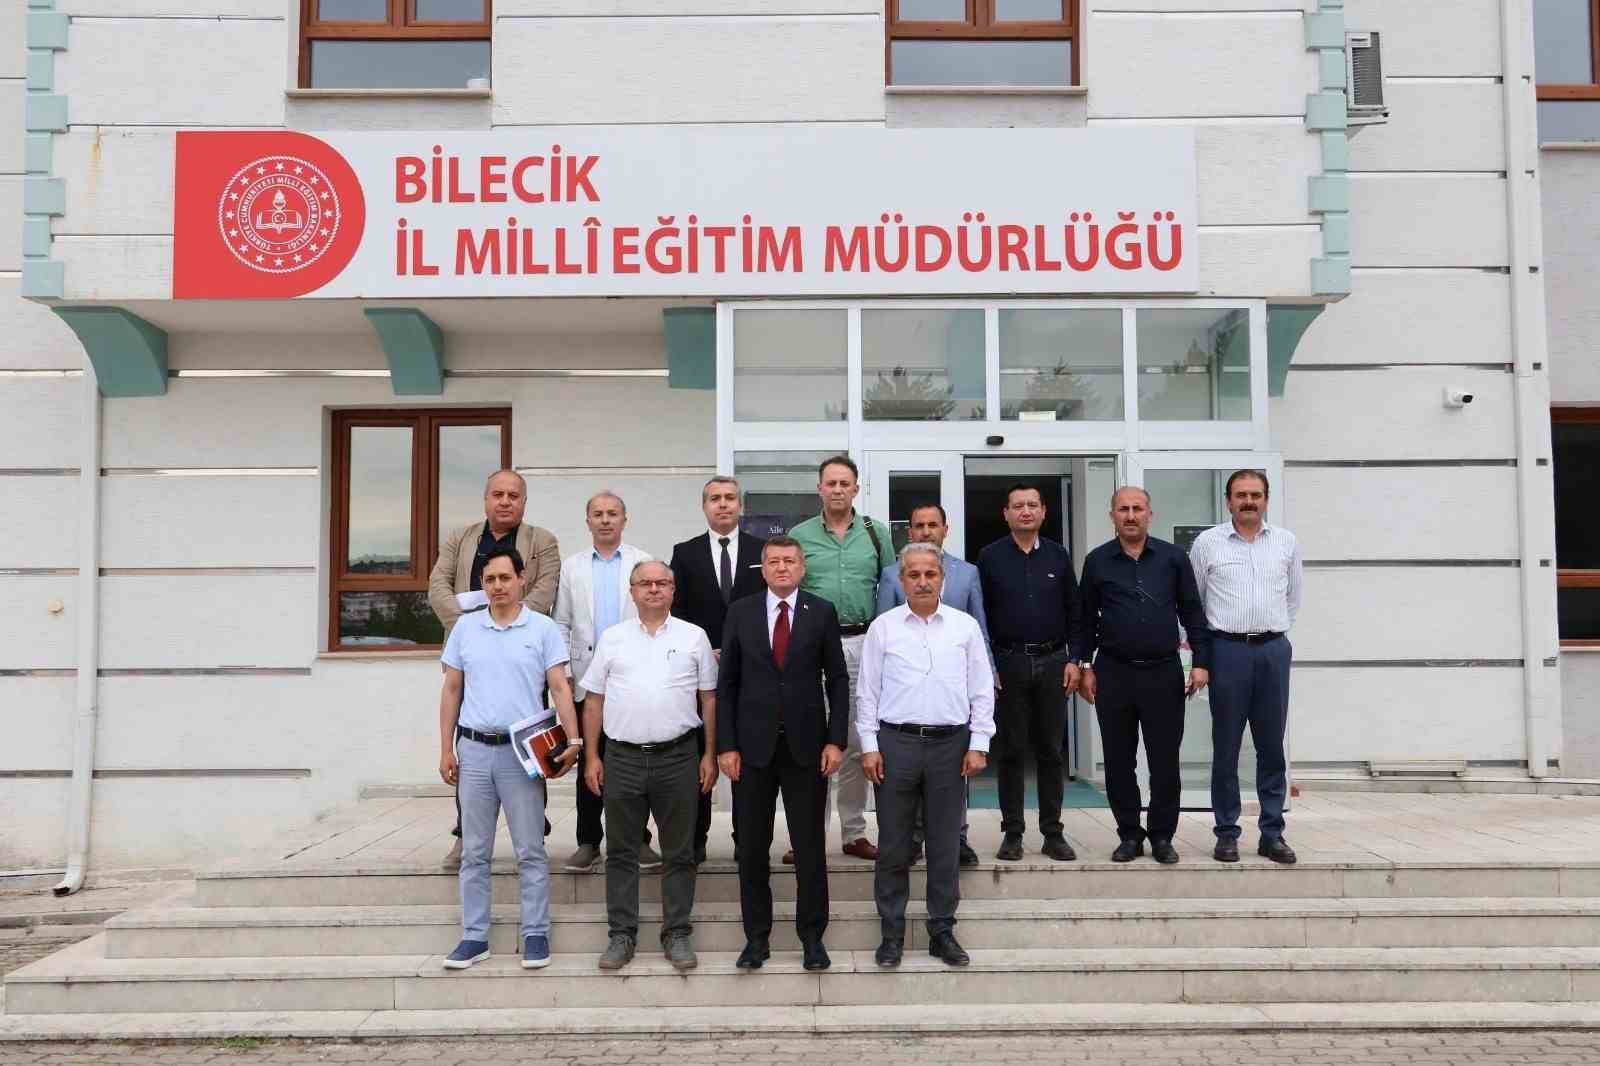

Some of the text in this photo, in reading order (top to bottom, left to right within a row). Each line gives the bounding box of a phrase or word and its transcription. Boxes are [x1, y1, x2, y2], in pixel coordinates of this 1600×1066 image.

[395, 144, 600, 204] BİLECİK
[395, 210, 1183, 277] İL MİLLÎ EĞİTİM MÜDÜRLÜĞÜ
